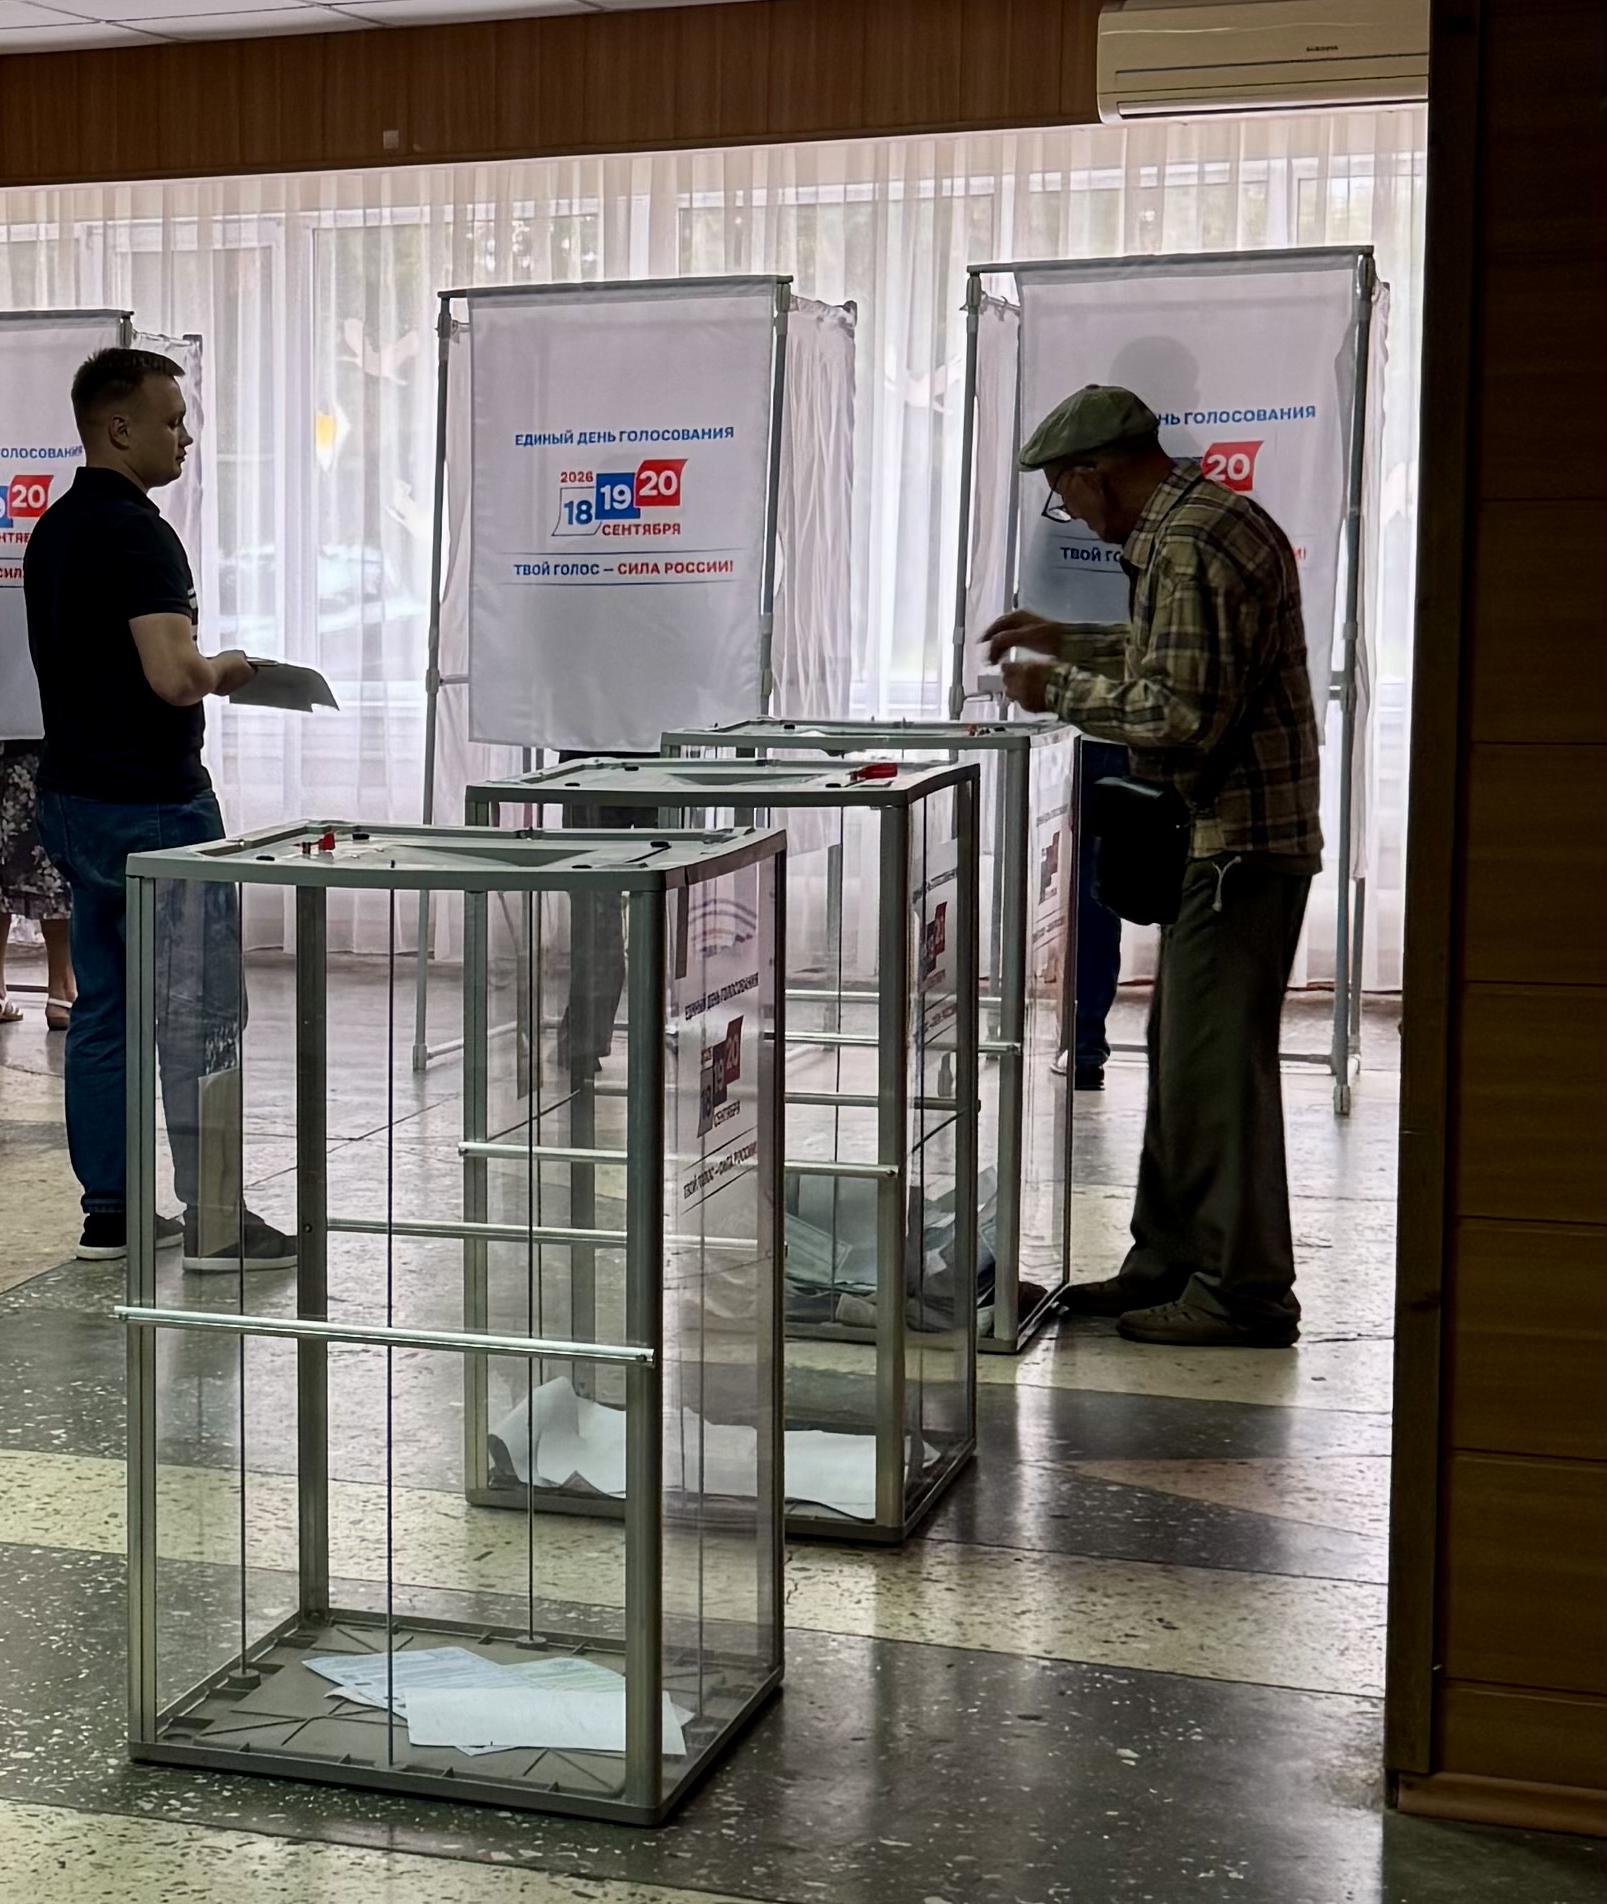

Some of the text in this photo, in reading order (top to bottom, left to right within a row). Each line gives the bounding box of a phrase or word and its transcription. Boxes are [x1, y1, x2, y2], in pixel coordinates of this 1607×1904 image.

[1184, 405, 1316, 425] ГОЛОСОВАНИЯ
[515, 426, 735, 447] ЕДИНЫЙ ДЕНЬ ГОЛОСОВАНИЯ
[560, 471, 594, 483] 2026
[1206, 453, 1250, 481] 20
[11, 484, 45, 508] 20
[564, 470, 678, 525] 18 19 20
[602, 522, 681, 537] СЕНТЯБРЯ
[1060, 546, 1101, 562] ТВОЙ
[514, 561, 550, 576] ТВОЙ
[553, 563, 600, 576] ГОЛОС
[617, 562, 661, 575] СИЛА
[664, 559, 734, 574] РОССИИ!
[726, 1033, 739, 1070] 20
